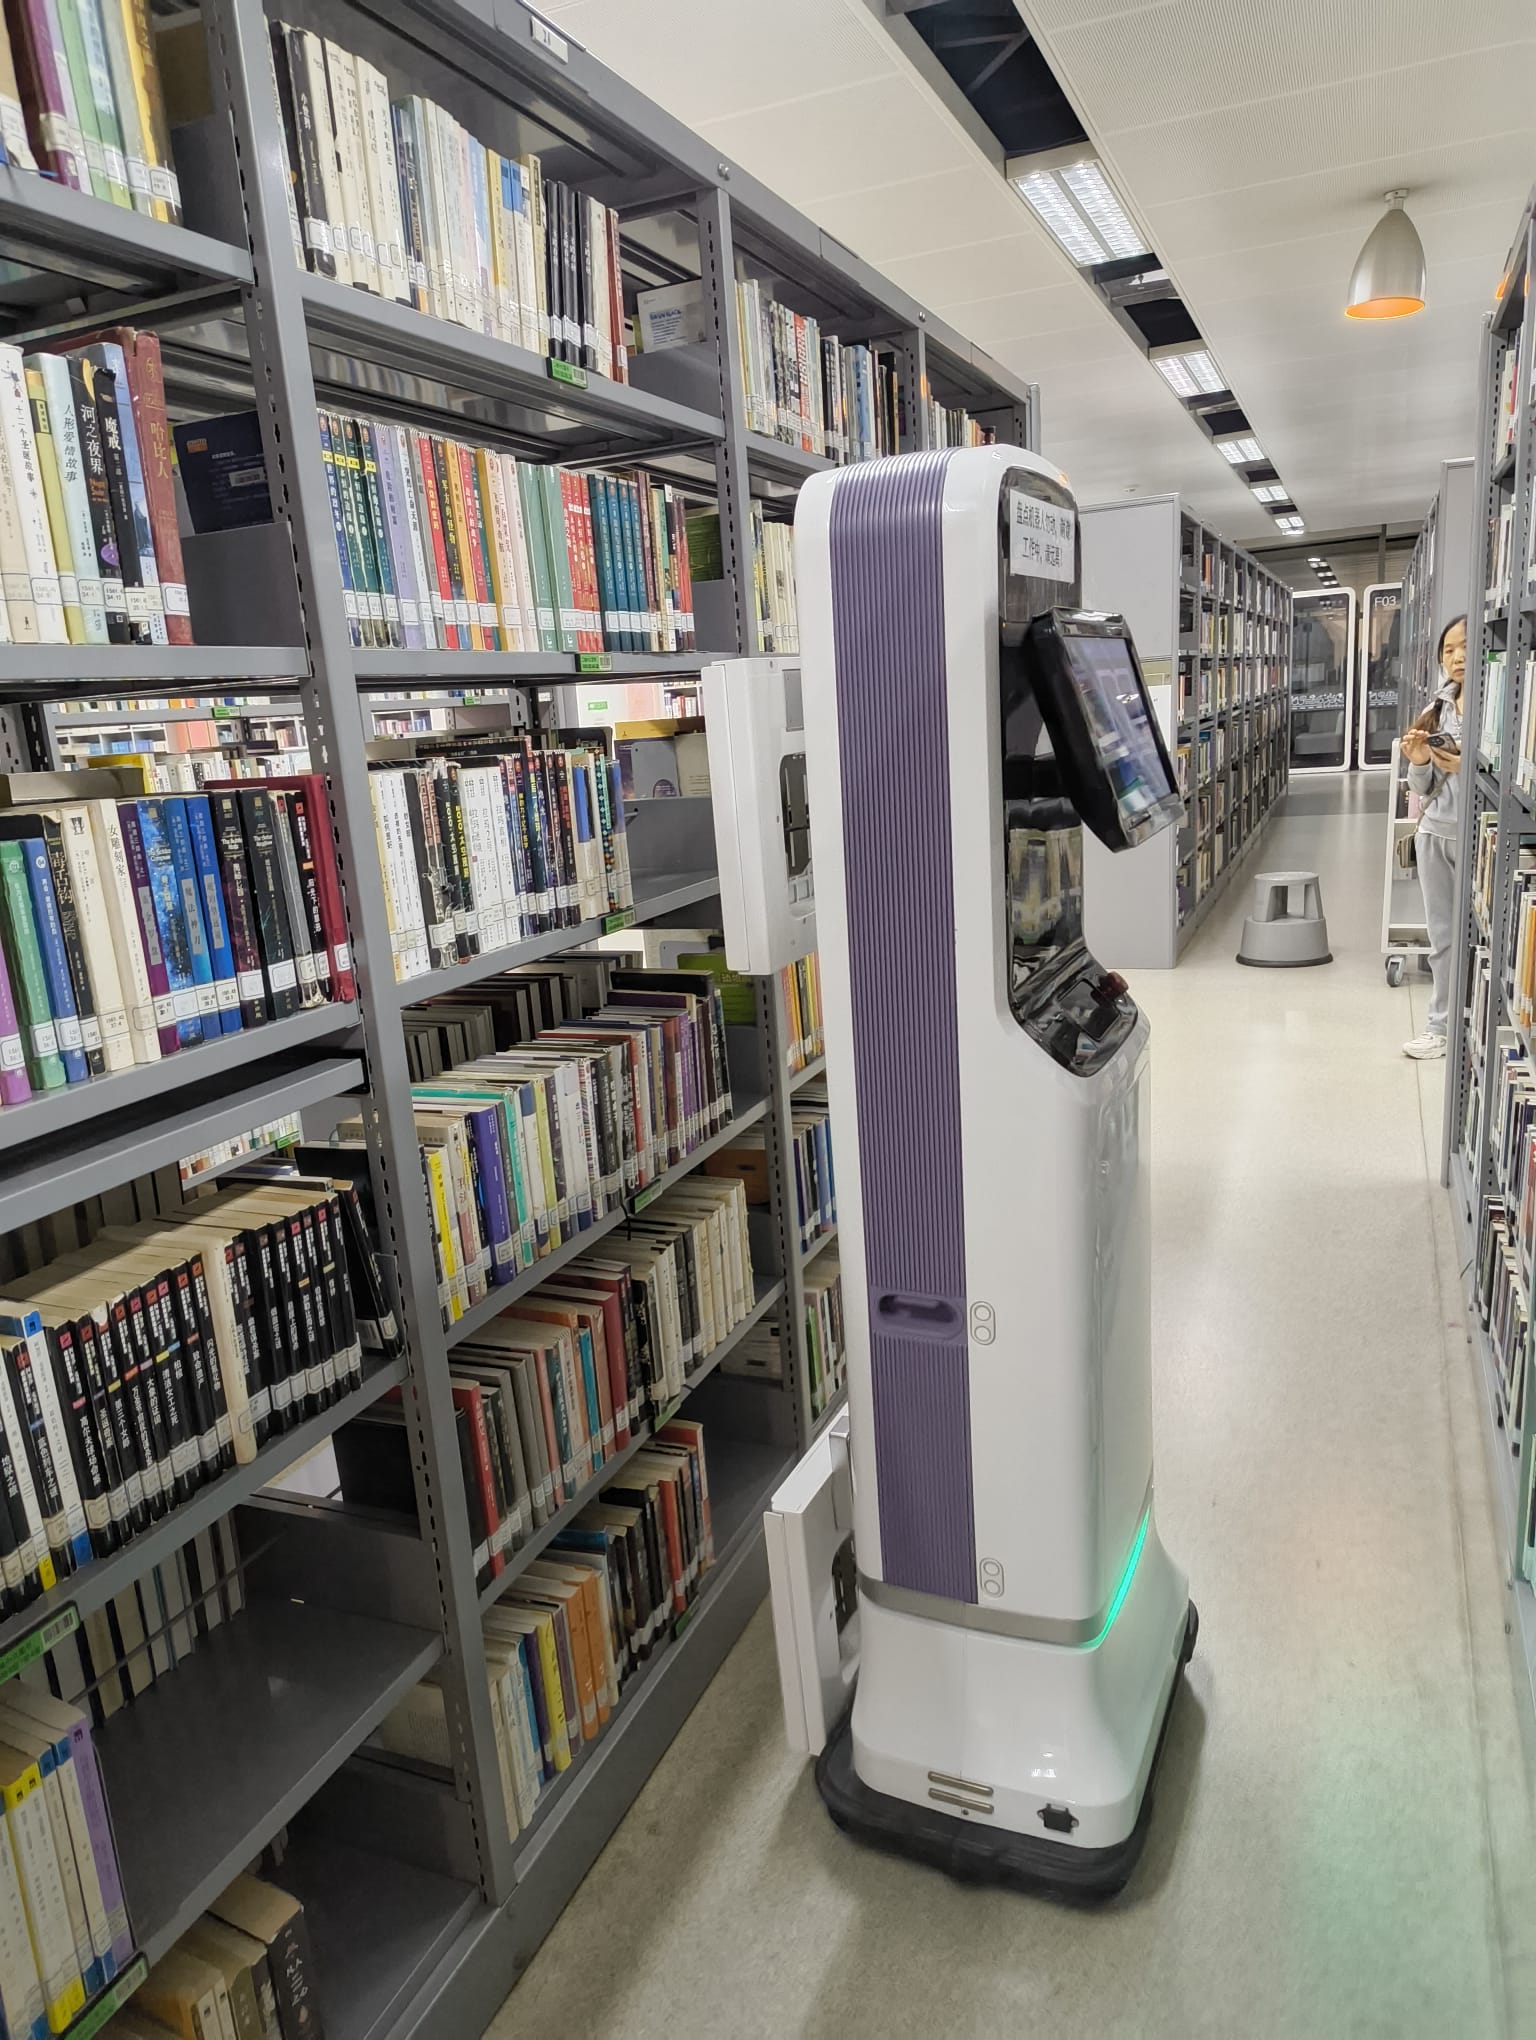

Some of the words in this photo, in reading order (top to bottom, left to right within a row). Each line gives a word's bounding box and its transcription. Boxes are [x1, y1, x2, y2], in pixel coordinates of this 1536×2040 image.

[80, 404, 104, 476] 河之夜界
[150, 422, 169, 480] 哈比人
[1374, 595, 1397, 607] F03
[115, 1398, 131, 1449] 第三个女郎
[147, 1378, 161, 1425] 大象的证词
[162, 1368, 179, 1426] 清洁女工之死
[37, 1435, 59, 1499] 蓝色列车之谜
